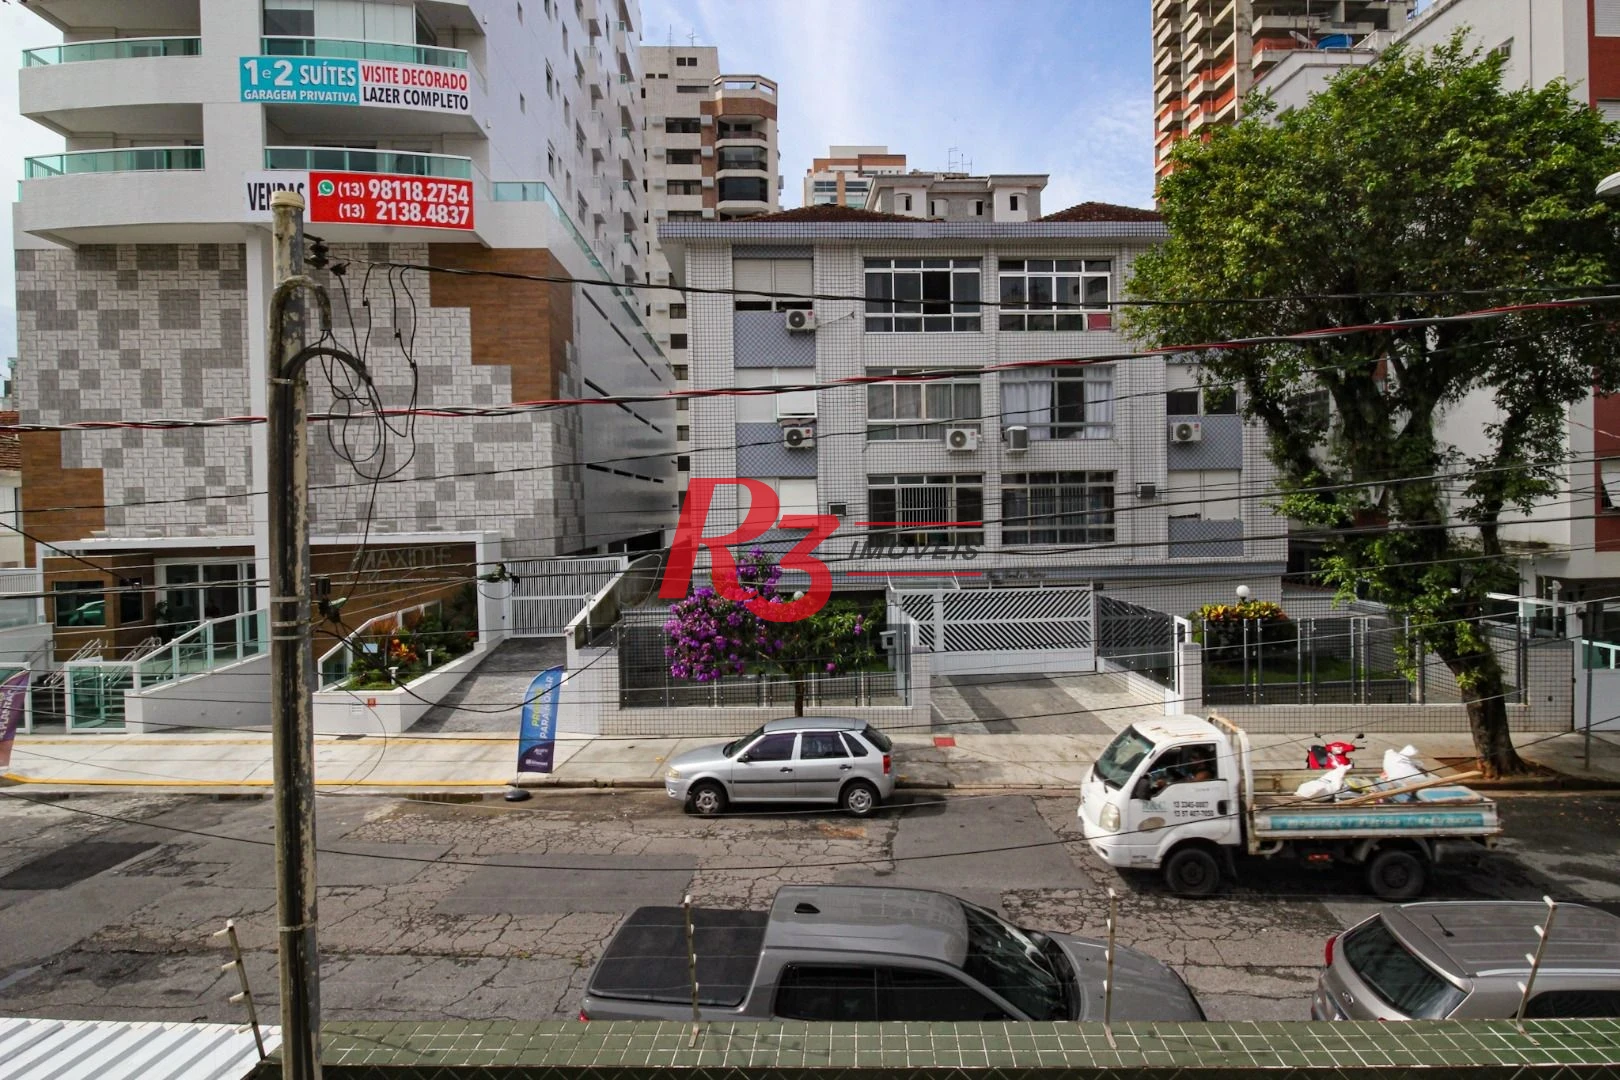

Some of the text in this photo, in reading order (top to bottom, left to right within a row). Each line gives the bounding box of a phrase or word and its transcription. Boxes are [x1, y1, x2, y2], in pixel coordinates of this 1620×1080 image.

[244, 60, 356, 87] 1 e 2 SUÍTES
[362, 65, 467, 91] VISITE DECORADO
[244, 89, 357, 103] GARAGEM PRIVATIVA
[363, 86, 468, 110] LAZER COMPLETO
[338, 179, 469, 204] (13) 98118.2754
[338, 201, 469, 224] (13) 2138.4837
